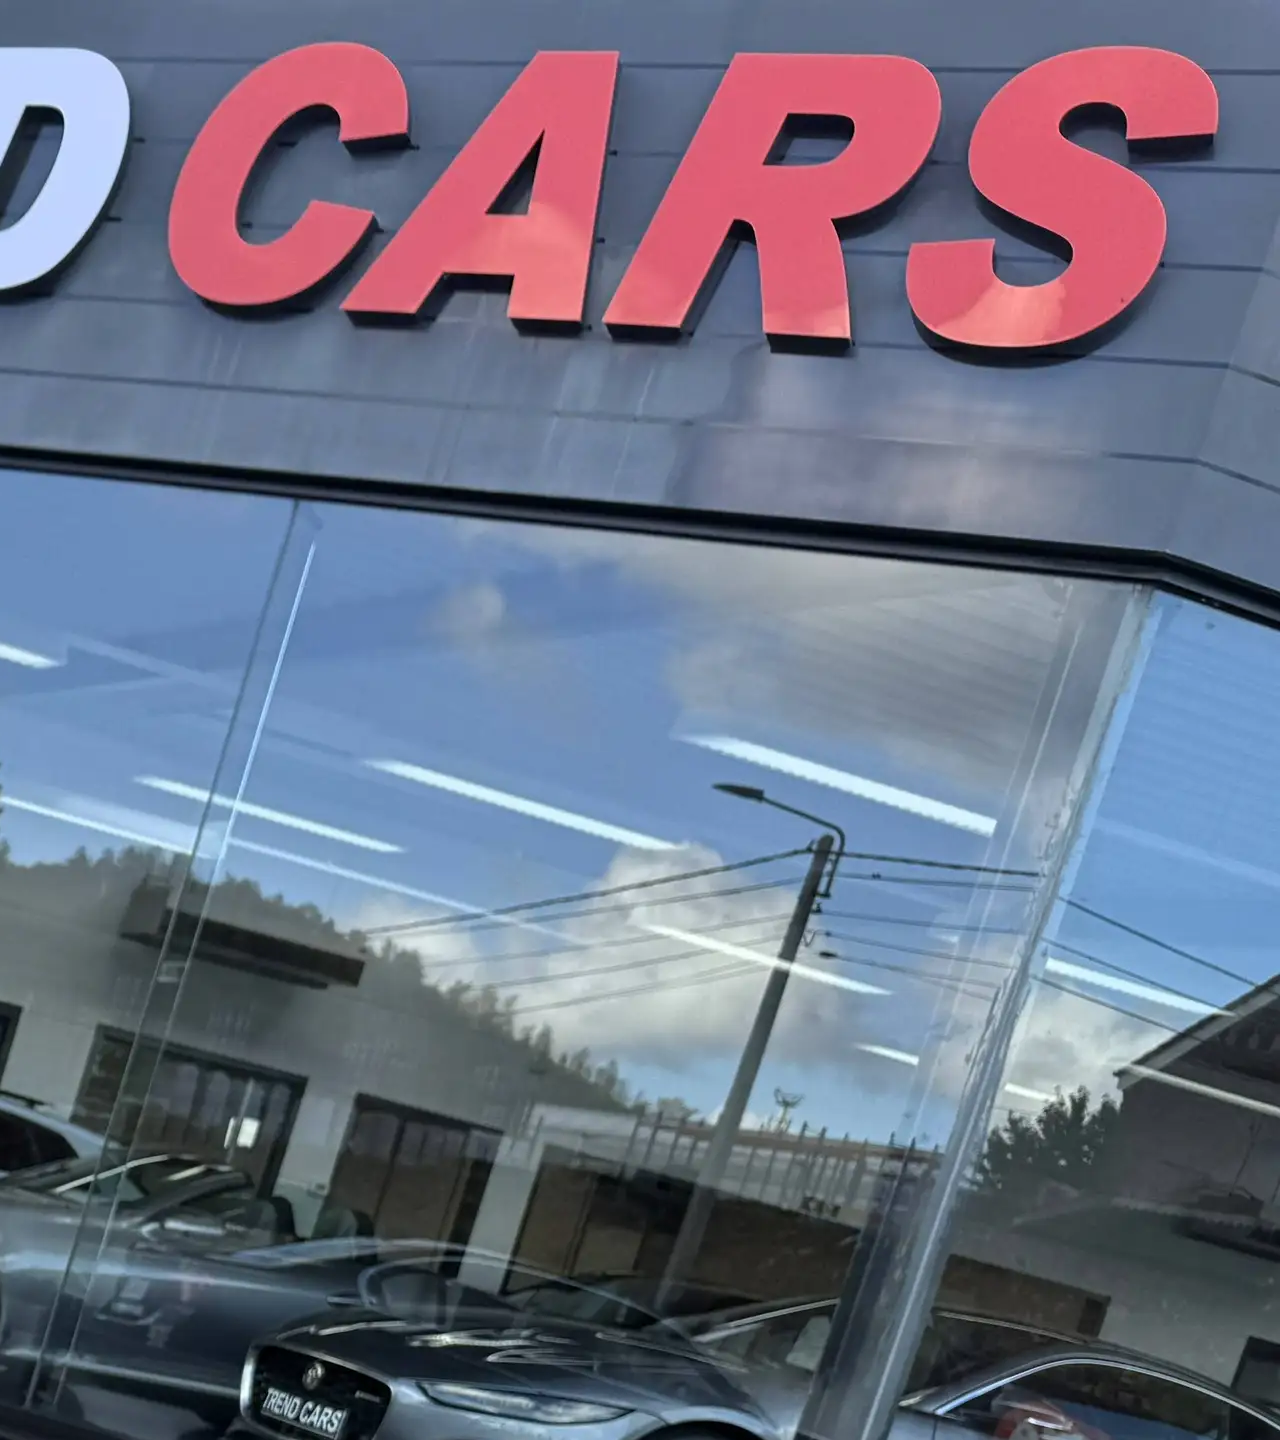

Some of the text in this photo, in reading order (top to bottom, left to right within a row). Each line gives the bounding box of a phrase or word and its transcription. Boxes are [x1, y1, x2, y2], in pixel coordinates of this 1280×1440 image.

[167, 41, 1219, 349] CARS
[263, 1387, 342, 1432] TREND CARS
